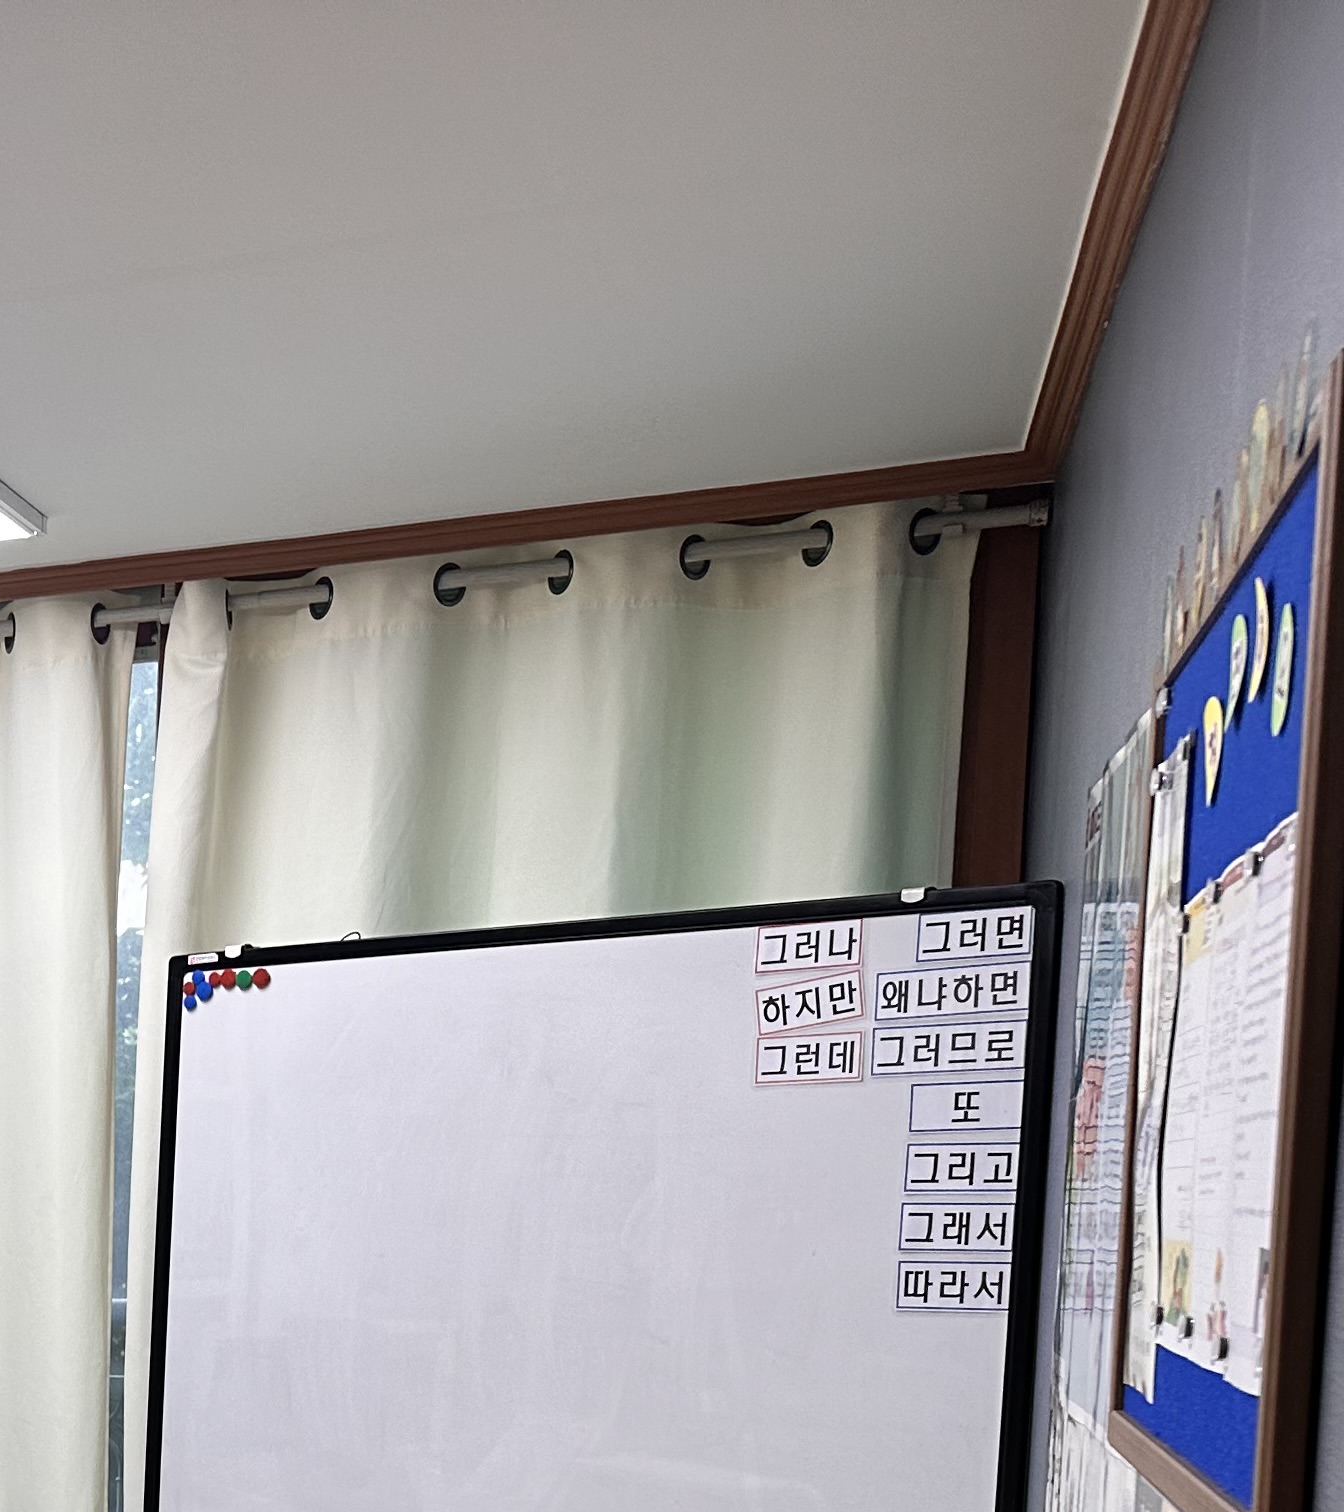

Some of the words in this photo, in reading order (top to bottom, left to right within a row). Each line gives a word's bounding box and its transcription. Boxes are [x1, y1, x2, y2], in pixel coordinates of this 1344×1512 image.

[759, 934, 858, 966] 그러나
[921, 913, 1025, 955] 그러면
[761, 980, 858, 1026] 하지만
[881, 970, 1020, 1013] 왜냐하면
[760, 1040, 857, 1077] 그런데
[876, 1030, 1015, 1068] 그러므로
[950, 1090, 981, 1123] 또
[909, 1151, 1014, 1187] 그리고
[904, 1211, 1008, 1247] 그래서
[902, 1269, 1004, 1305] 따라서
